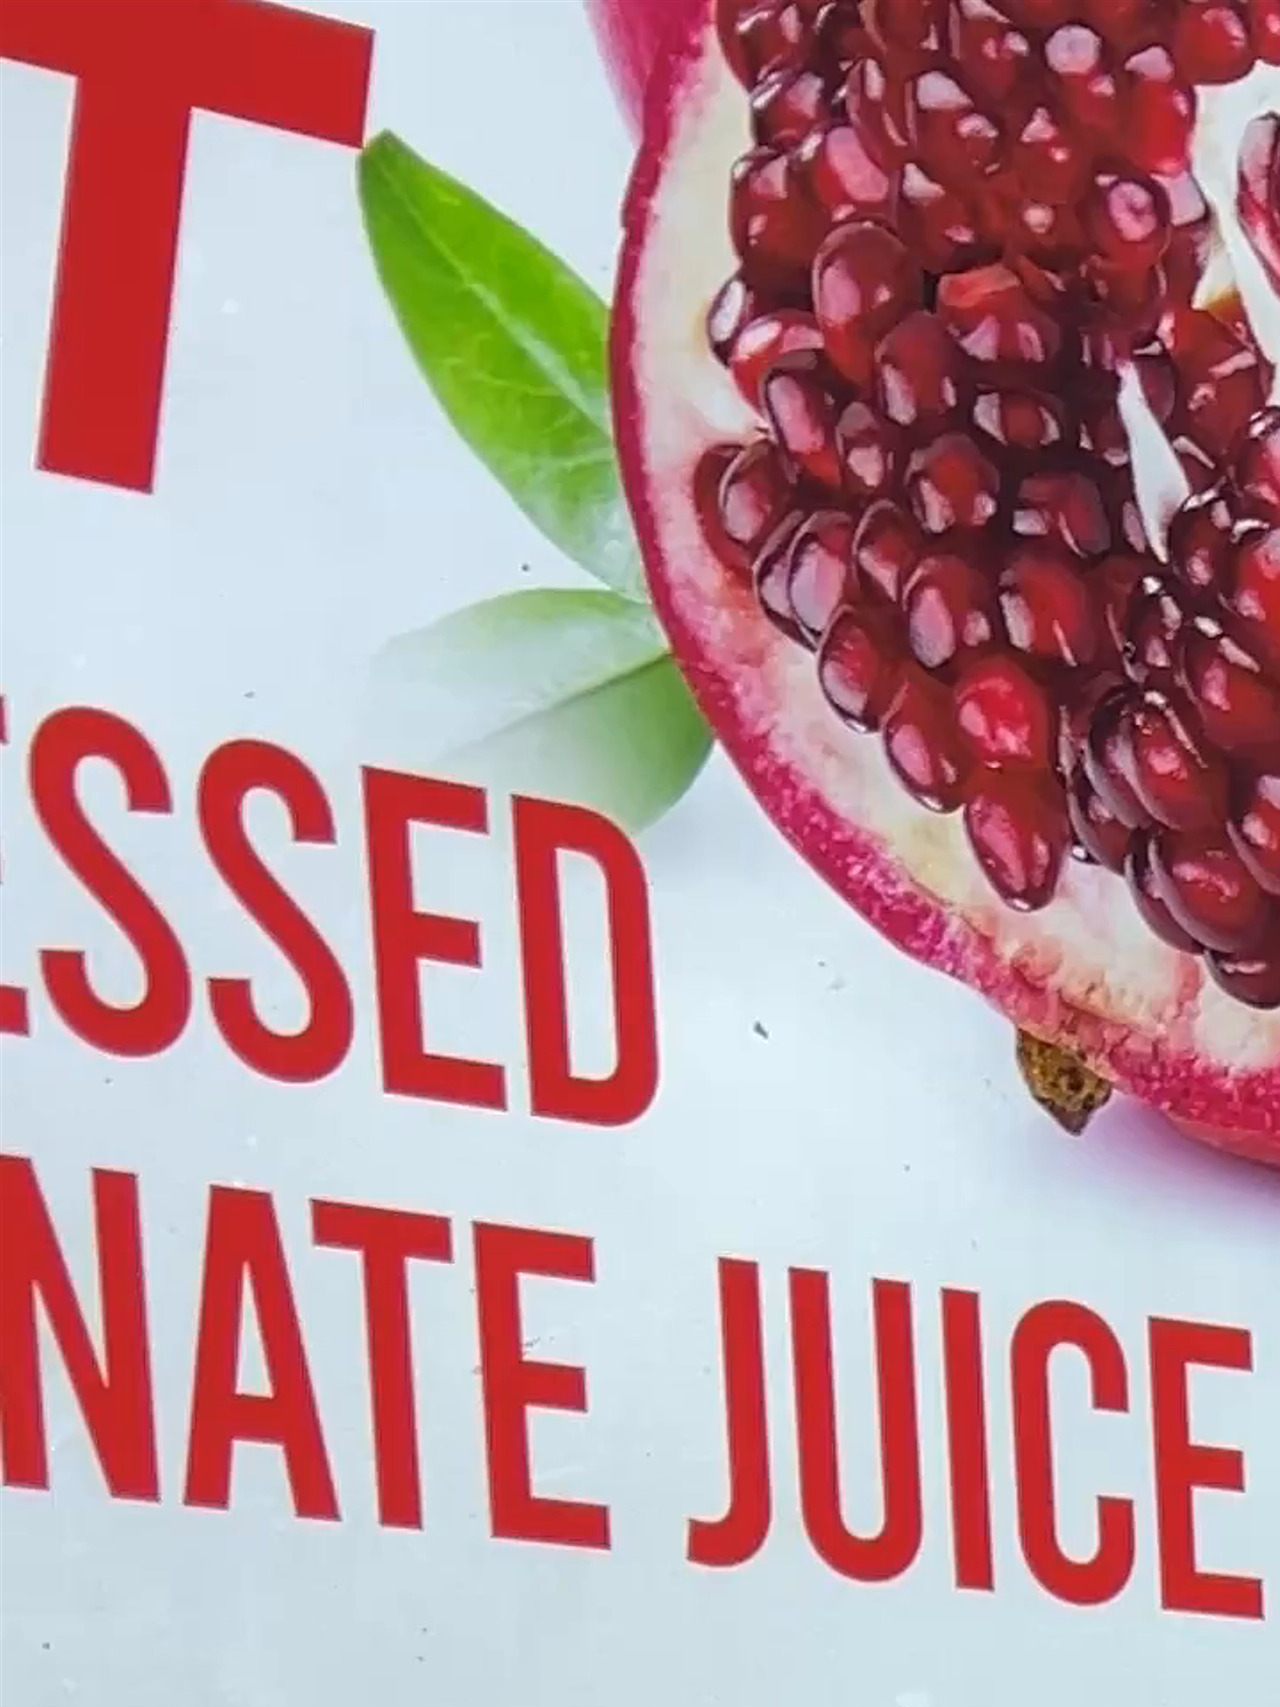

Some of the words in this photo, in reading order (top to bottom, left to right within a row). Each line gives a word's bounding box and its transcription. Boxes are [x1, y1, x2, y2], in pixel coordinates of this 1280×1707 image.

[0, 694, 660, 1127] SSED
[0, 1152, 612, 1550] NATE
[686, 1256, 1266, 1620] JUICE
